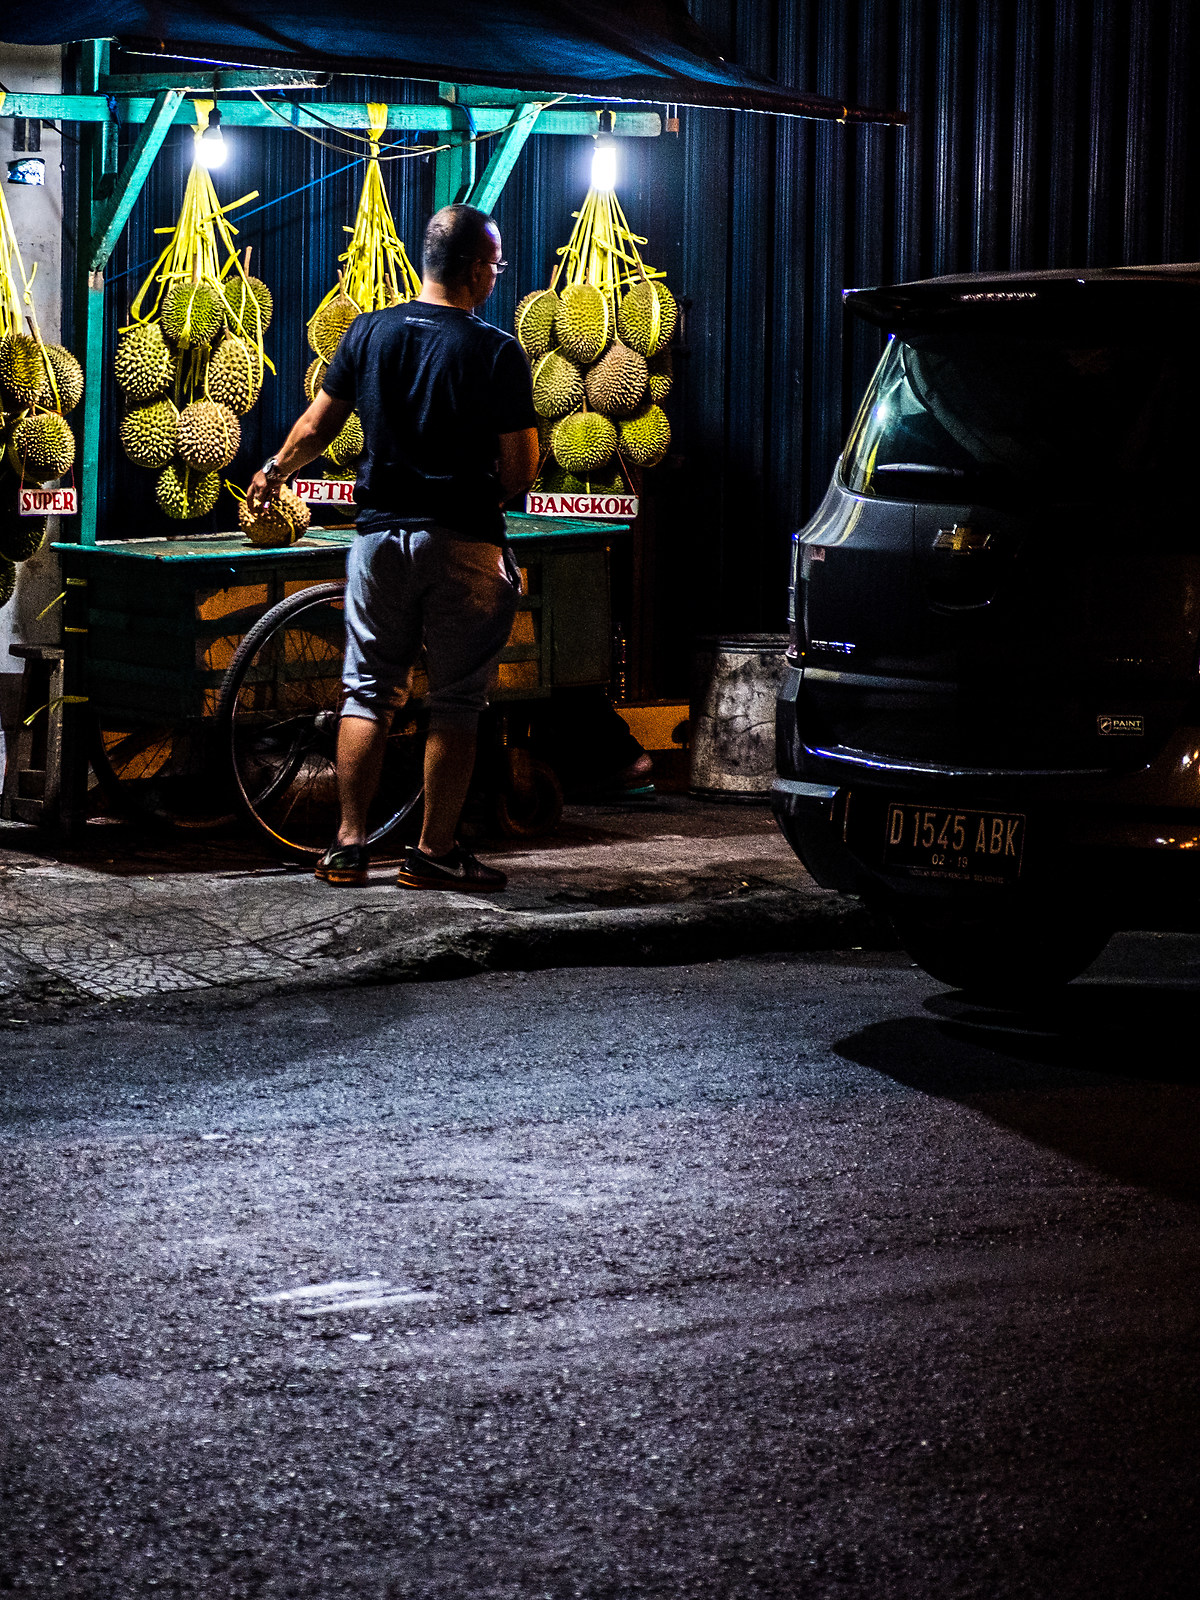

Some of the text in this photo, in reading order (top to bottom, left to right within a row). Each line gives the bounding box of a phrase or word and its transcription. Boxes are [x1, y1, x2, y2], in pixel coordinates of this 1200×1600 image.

[21, 491, 75, 512] SUPER
[296, 481, 355, 503] PETR
[529, 495, 637, 516] BANGKOK
[1112, 719, 1142, 727] PAINT
[889, 808, 1021, 857] D 1545 ABK
